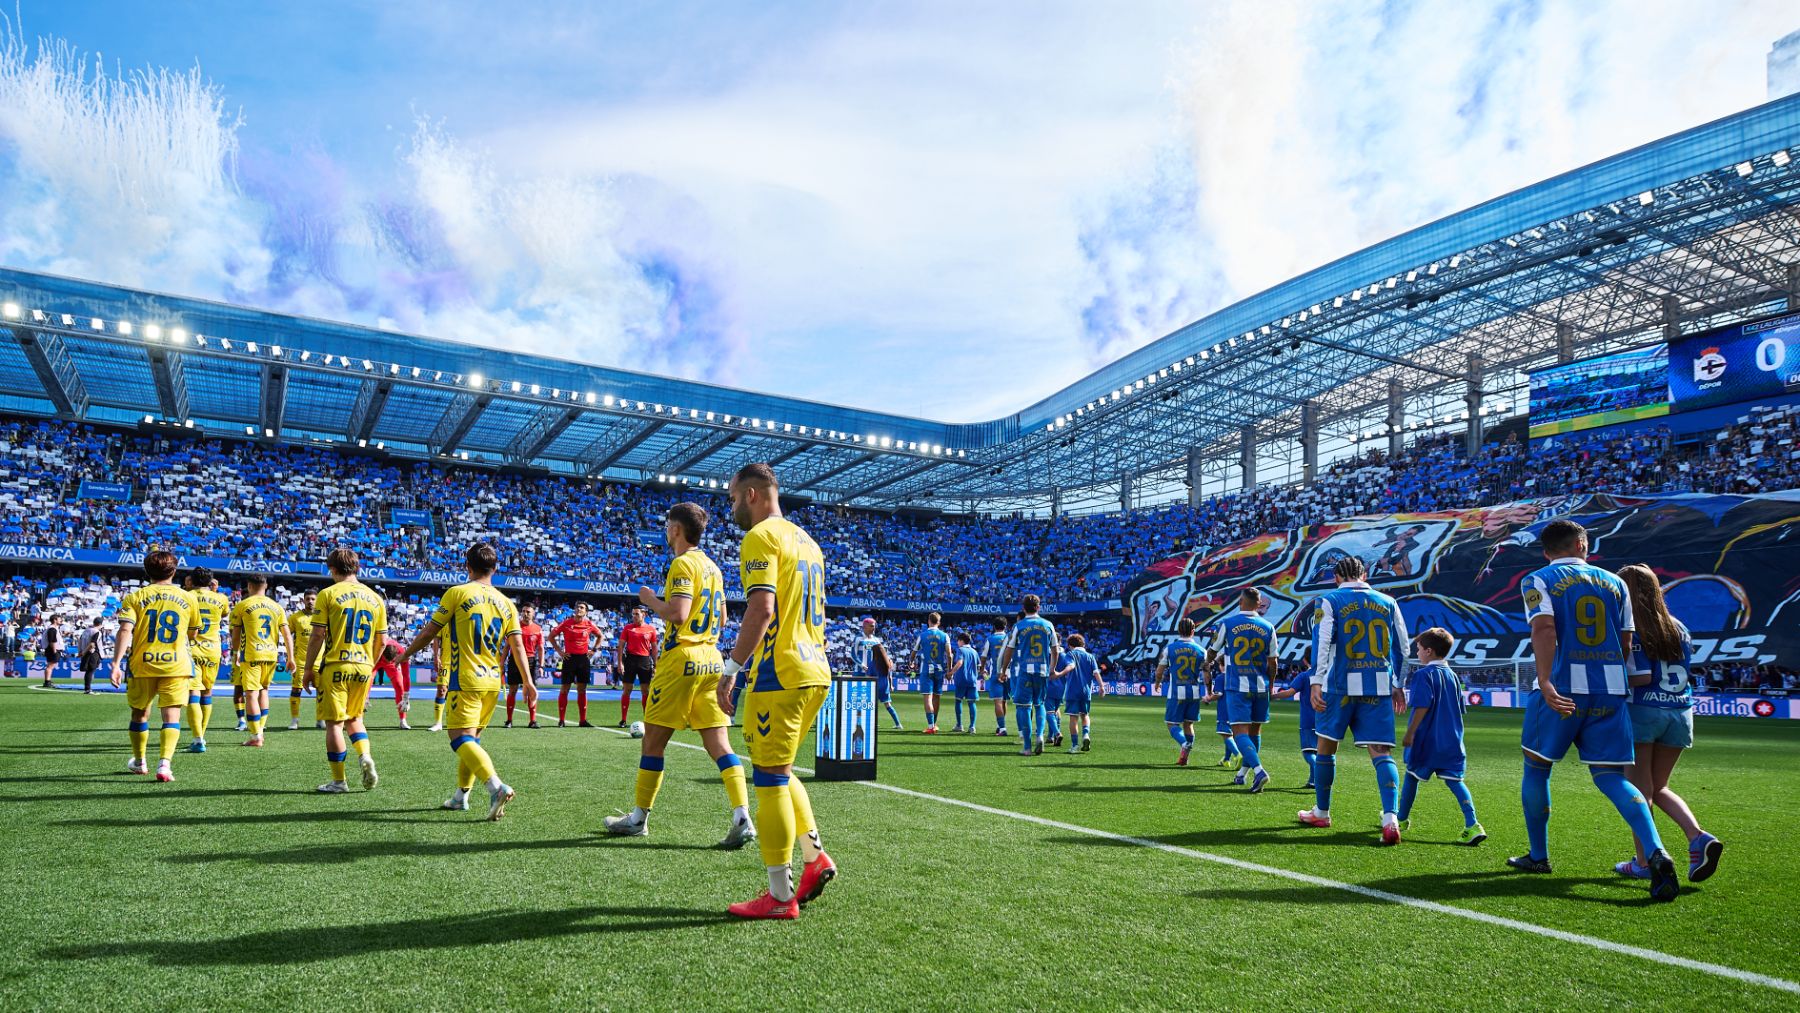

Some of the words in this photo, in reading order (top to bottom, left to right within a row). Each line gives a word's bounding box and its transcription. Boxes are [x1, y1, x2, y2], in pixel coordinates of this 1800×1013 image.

[1755, 337, 1786, 372] 0
[5, 545, 75, 560] ABANCA
[589, 581, 631, 593] ABANCA
[795, 560, 824, 627] 10
[690, 588, 722, 636] 39
[855, 599, 887, 608] ABANCA
[911, 601, 943, 611] ABANCA
[967, 603, 1002, 613] ABANCA
[145, 608, 180, 644] 18
[257, 614, 272, 639] 3
[341, 607, 374, 645] 16
[1575, 595, 1607, 647] 9
[1030, 634, 1043, 657] 5
[1342, 618, 1391, 660] 20
[142, 652, 178, 662] DIGI
[929, 641, 939, 659] 3
[1232, 636, 1266, 667] 22
[332, 671, 369, 683] Binter
[845, 701, 874, 710] DEPOR
[1649, 692, 1692, 704] ABANC
